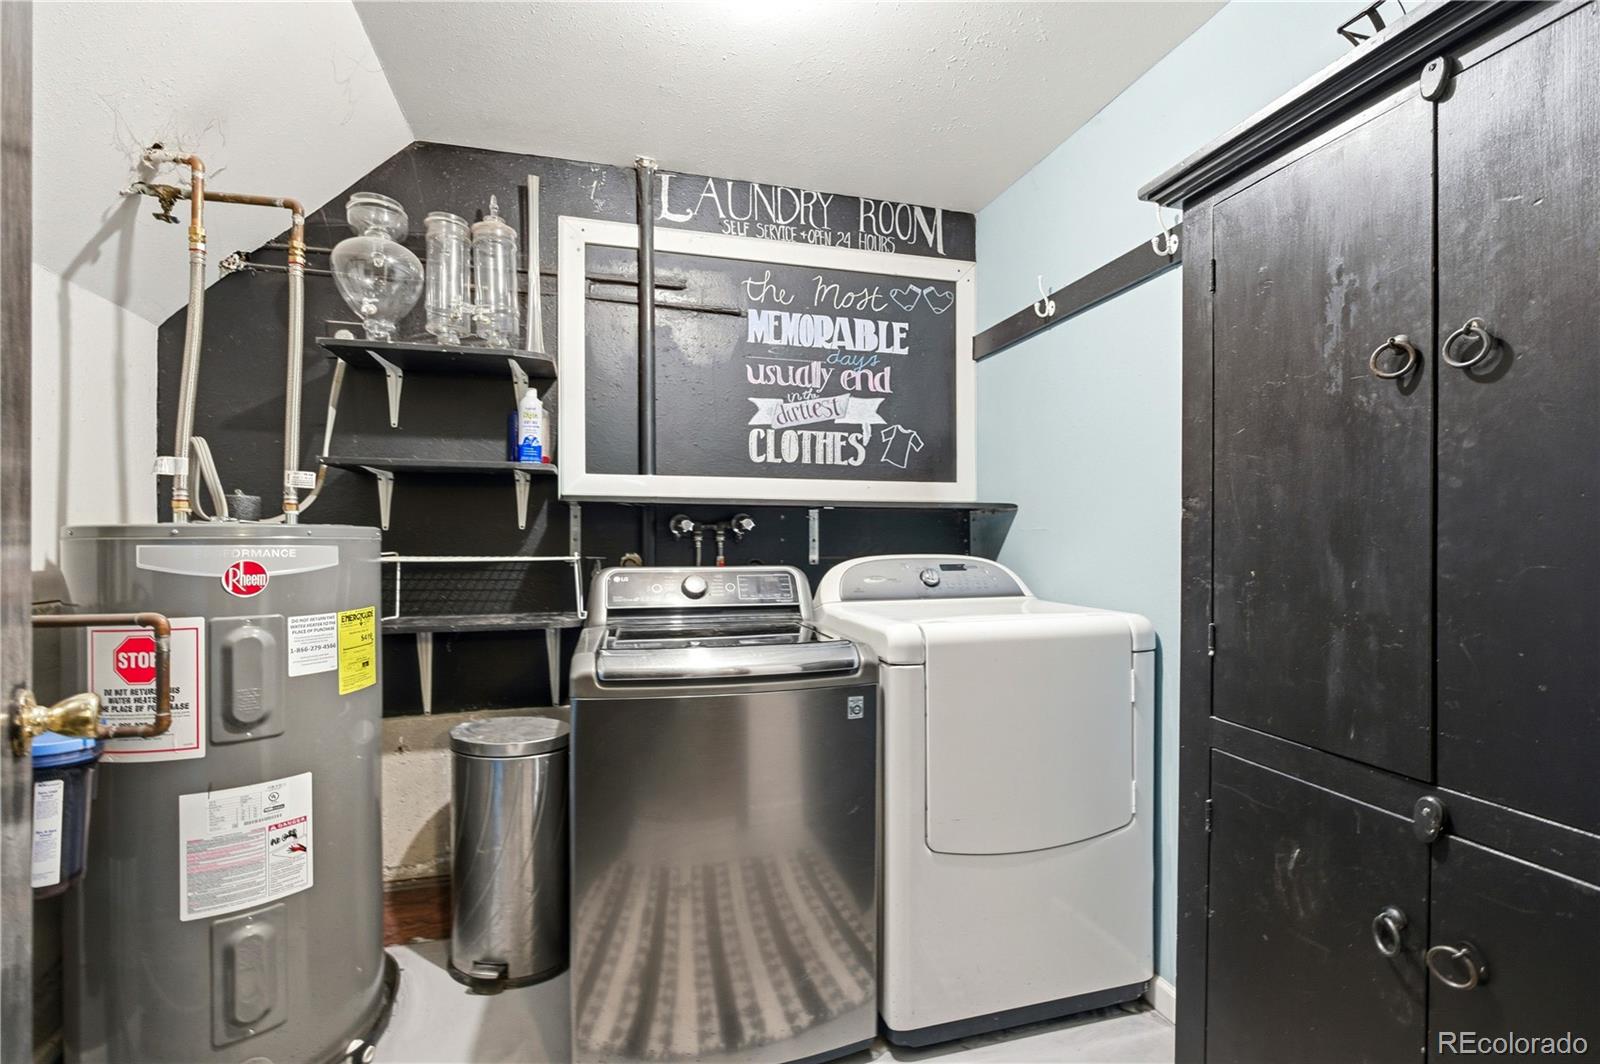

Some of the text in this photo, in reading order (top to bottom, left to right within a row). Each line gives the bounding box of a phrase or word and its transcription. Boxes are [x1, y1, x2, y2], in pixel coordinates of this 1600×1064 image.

[655, 173, 947, 256] LAUNDRY ROOM
[721, 219, 750, 236] SELF
[756, 224, 798, 243] SERVICE
[835, 232, 852, 249] 24
[858, 233, 897, 254] HOURS
[742, 270, 796, 305] the
[747, 309, 909, 355] MEMORABLE
[826, 350, 881, 371] days
[746, 361, 894, 394] usually end
[776, 397, 843, 426] dirtiest
[787, 392, 802, 402] in
[748, 429, 867, 466] CLOTHES
[228, 559, 267, 592] Rheem
[114, 688, 128, 696] NOT
[111, 705, 133, 713] PLACE
